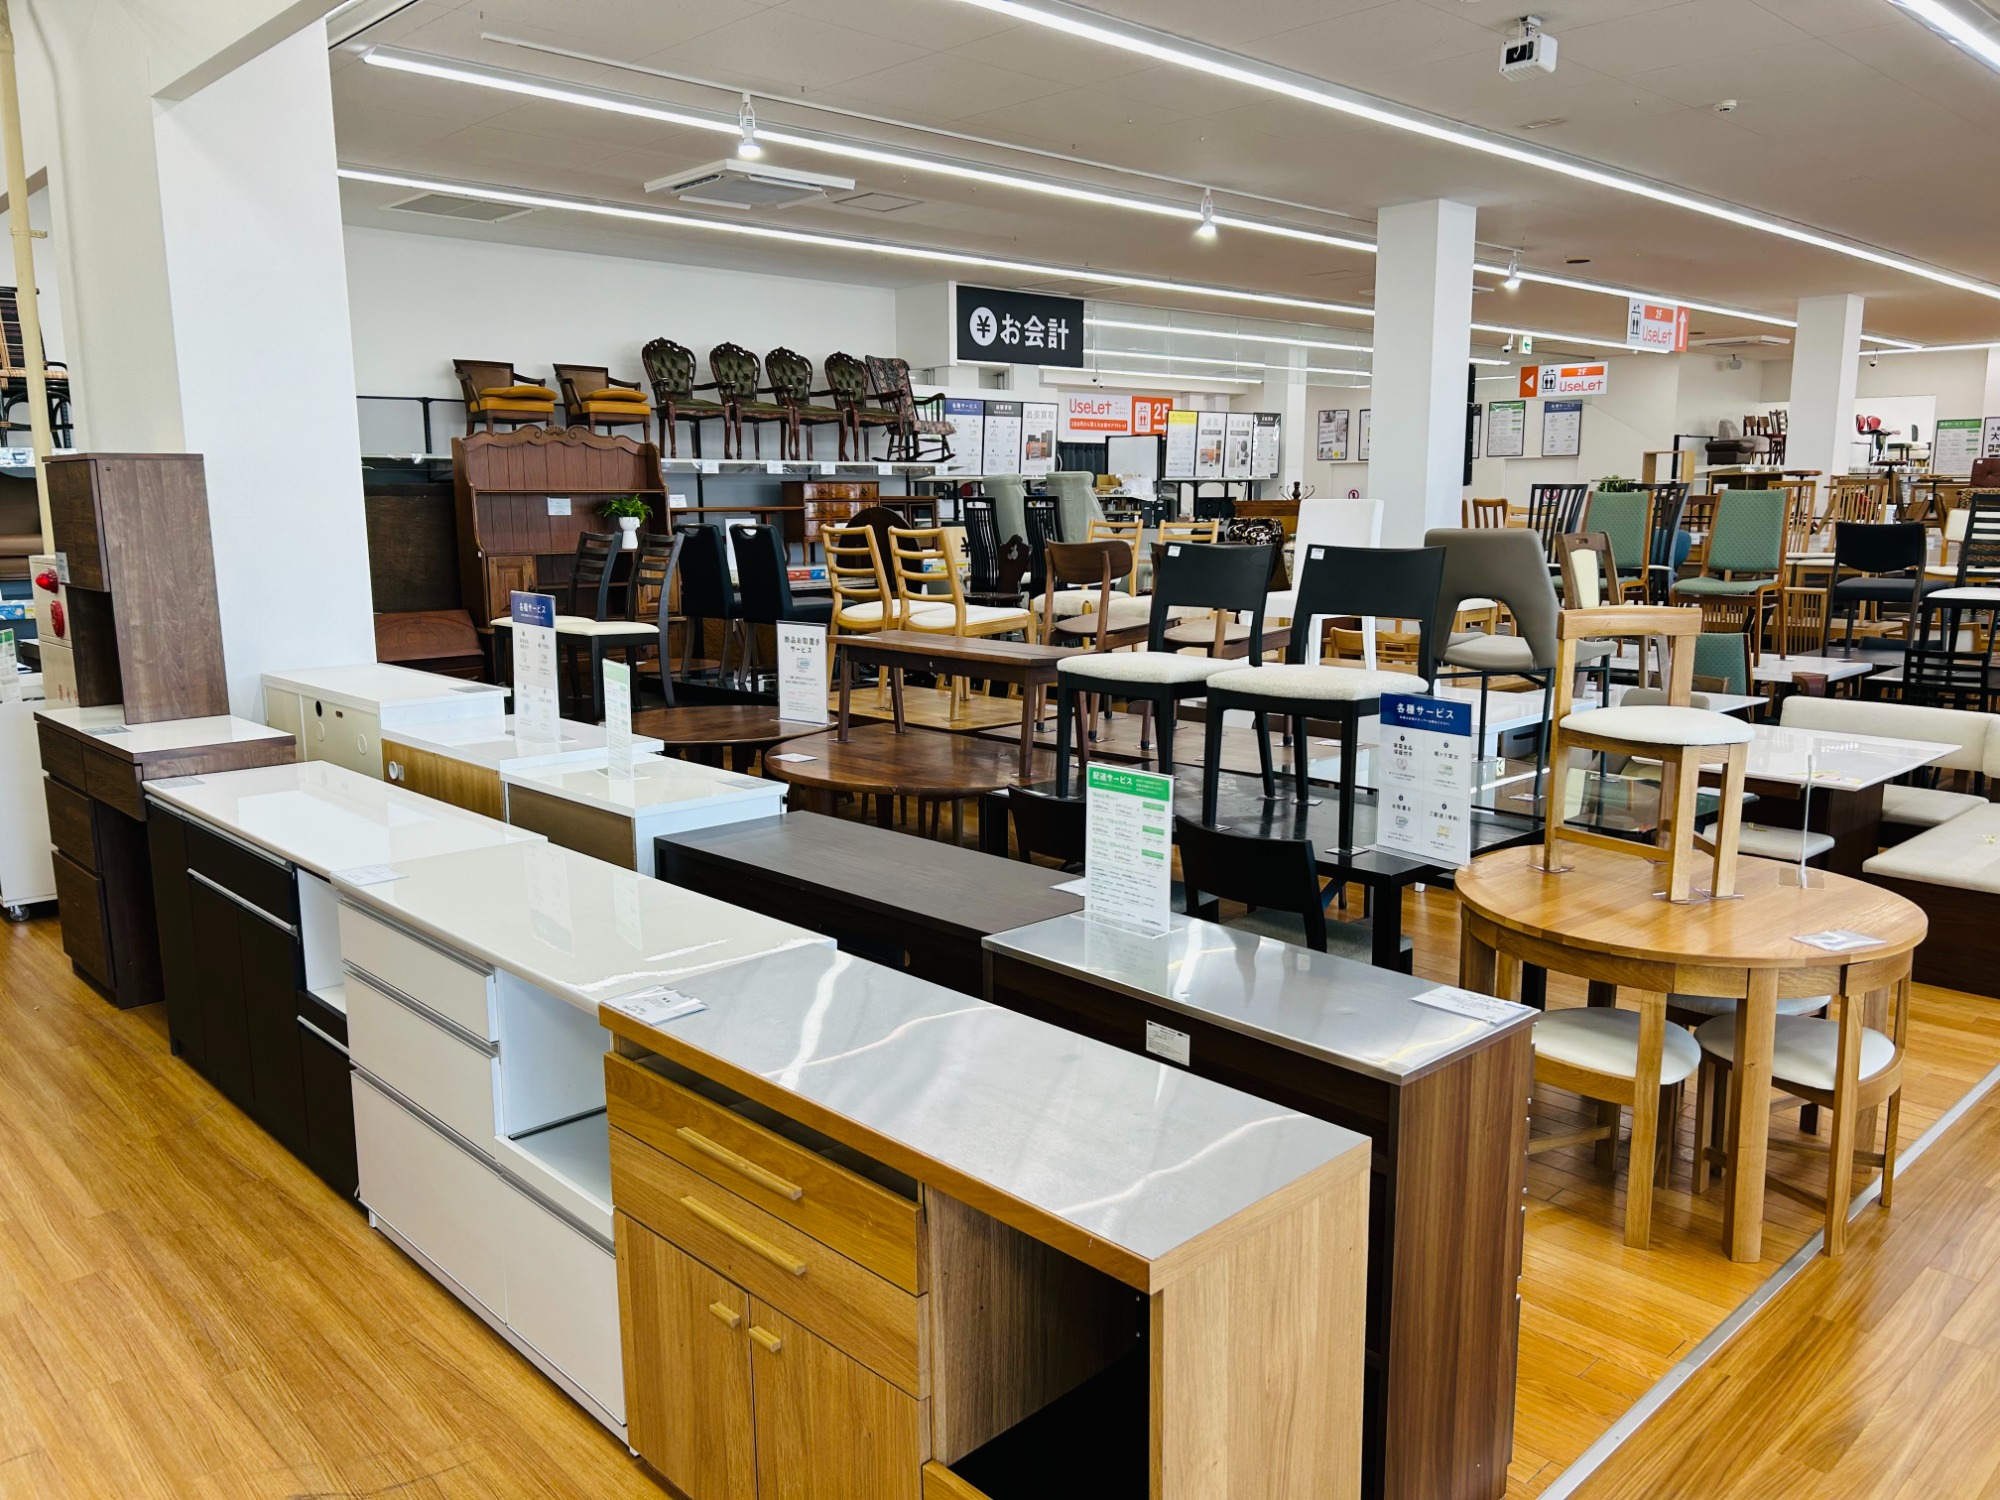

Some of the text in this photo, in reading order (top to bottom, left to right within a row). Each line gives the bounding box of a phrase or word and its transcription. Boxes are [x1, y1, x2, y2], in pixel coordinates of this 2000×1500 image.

[1655, 309, 1663, 319] 2F
[1000, 313, 1069, 350] お会計
[1642, 325, 1672, 344] UseLet
[1559, 380, 1603, 392] UseLet
[1069, 398, 1112, 415] UseLet
[1153, 403, 1170, 419] 2F
[1396, 702, 1454, 719] 各種サービス
[1092, 771, 1133, 785] 配送サービス
